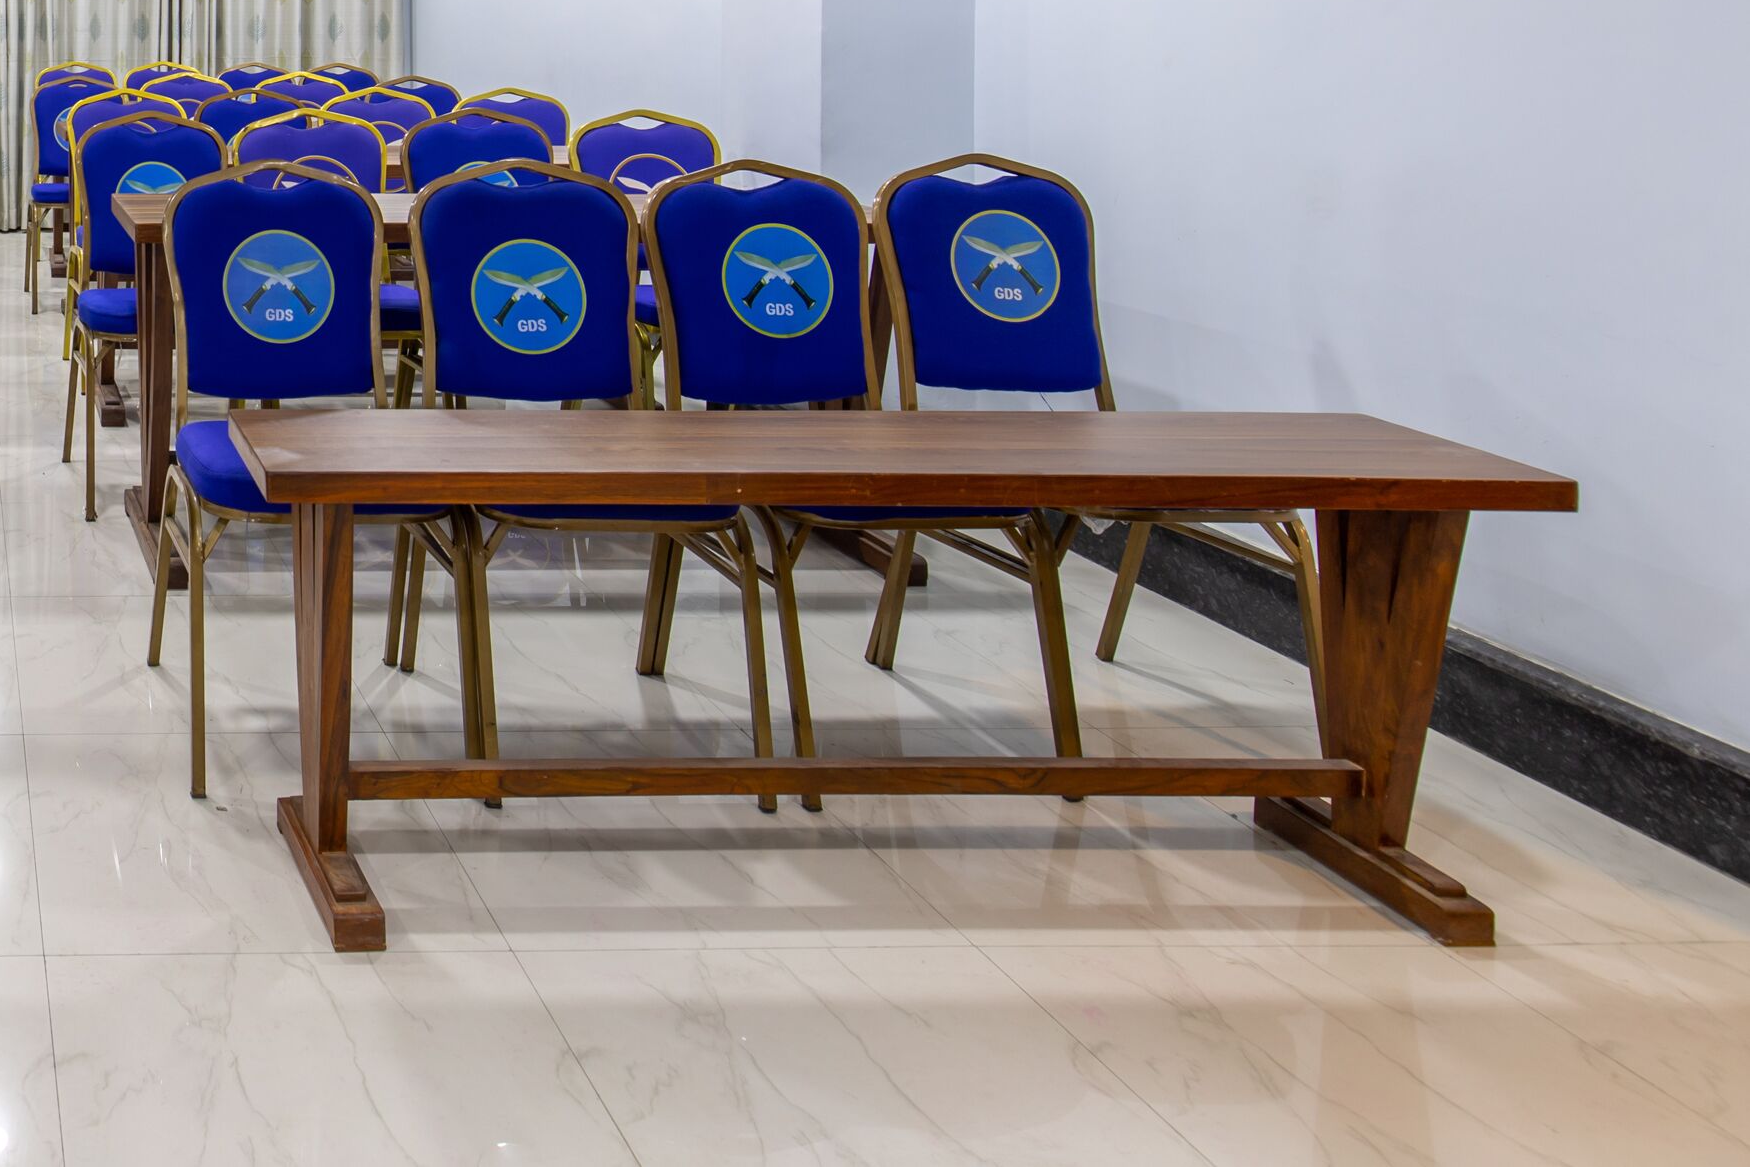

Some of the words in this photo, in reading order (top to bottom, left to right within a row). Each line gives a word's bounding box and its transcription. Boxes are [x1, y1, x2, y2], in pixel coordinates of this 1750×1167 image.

[994, 286, 1023, 301] GDS
[265, 308, 294, 322] GDS
[765, 303, 795, 316] GDS
[517, 318, 548, 333] GDS
